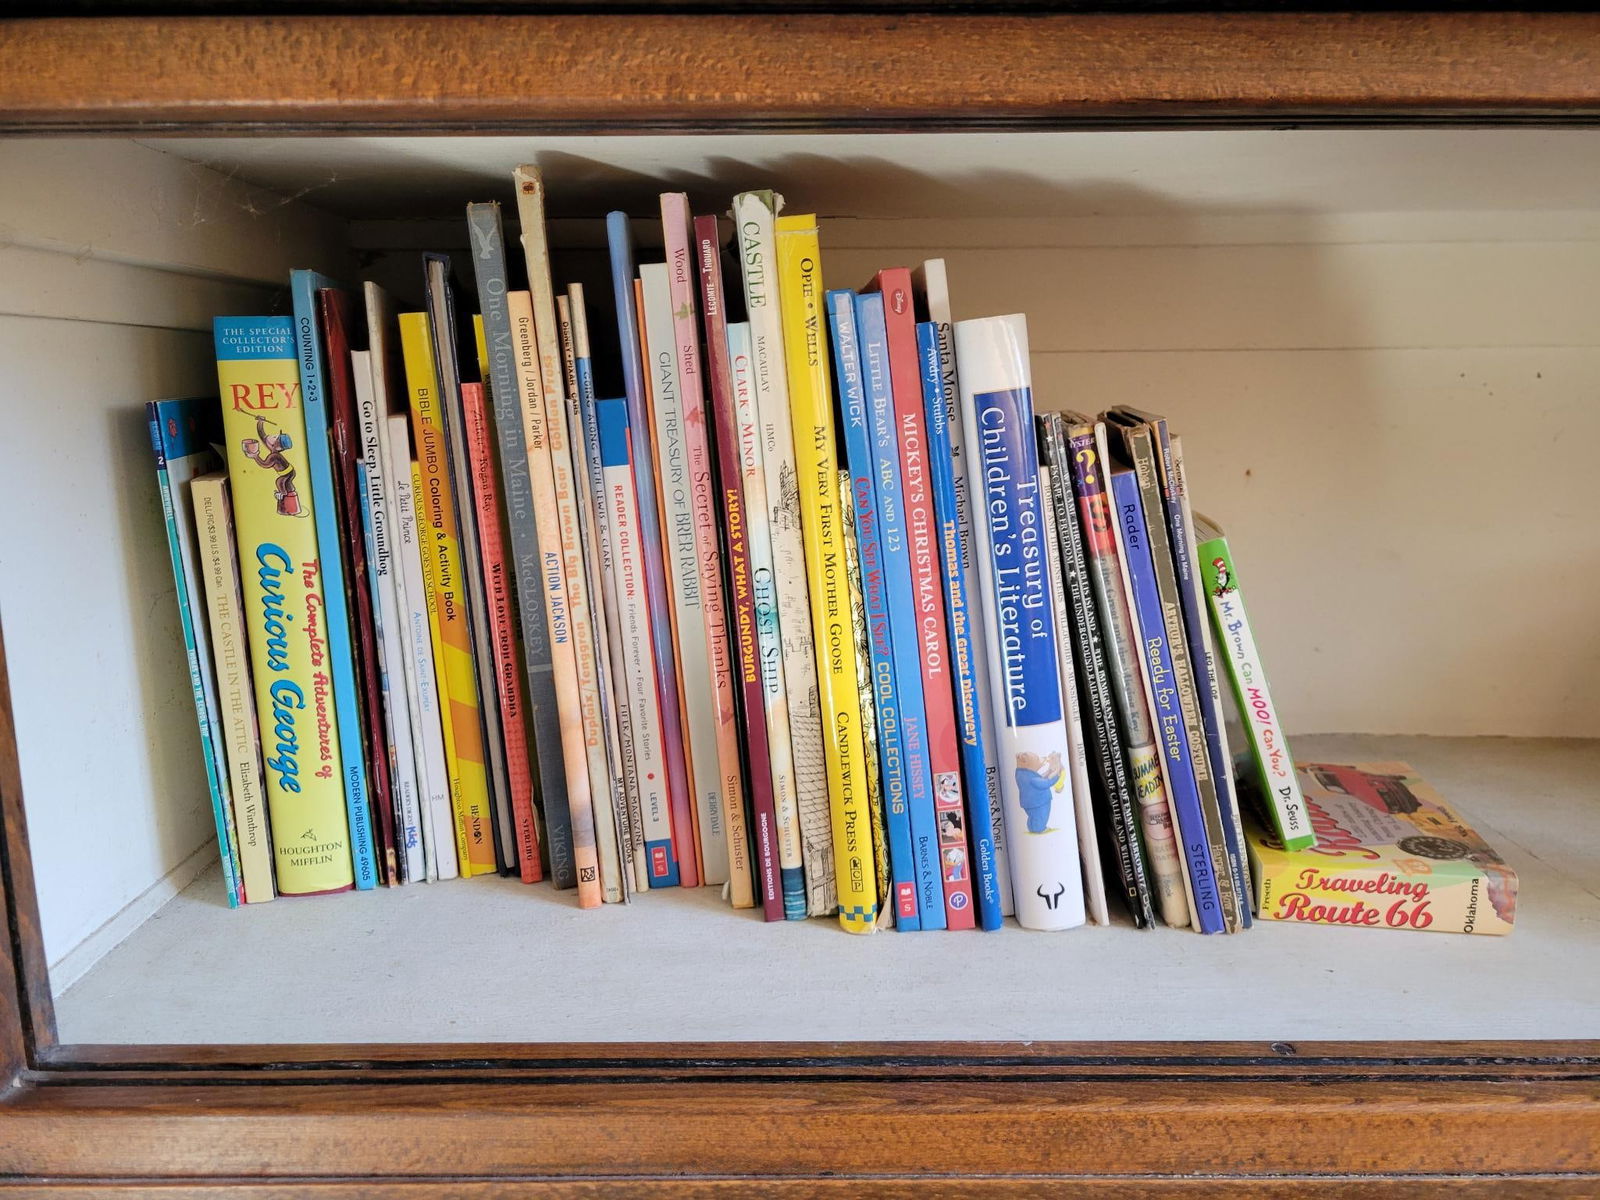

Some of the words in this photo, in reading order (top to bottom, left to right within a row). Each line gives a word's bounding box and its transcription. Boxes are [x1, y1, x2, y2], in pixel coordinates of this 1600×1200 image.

[674, 247, 686, 283] Wood
[743, 221, 767, 308] CASTLE
[800, 257, 813, 296] OPIE
[486, 277, 504, 321] One
[894, 289, 904, 313] Disney
[222, 336, 296, 345] COLLECTOR'S
[224, 328, 246, 336] THE
[249, 327, 293, 336] SPECIAL
[236, 344, 284, 353] EDITION
[300, 316, 314, 370] COUNTING
[804, 315, 817, 366] WELLS
[937, 321, 950, 365] Santa
[494, 331, 524, 420] Morning
[658, 351, 674, 402] GIANT
[682, 344, 694, 375] Shed
[757, 335, 769, 392] MACAULAY
[839, 321, 855, 382] WALTER
[847, 386, 861, 427] WICK
[868, 341, 882, 391] LITTLE
[230, 383, 300, 410] REY
[518, 316, 531, 367] Greenberg
[525, 376, 537, 409] Jordan
[531, 418, 542, 449] Parker
[582, 370, 592, 408] GOING
[734, 354, 747, 408] CLARK
[942, 369, 955, 422] Mouse
[361, 399, 373, 417] Go
[417, 388, 432, 426] BIBLE
[873, 397, 889, 447] BEAR'S
[363, 420, 373, 433] to
[505, 425, 527, 449] in
[587, 412, 597, 450] ALONG
[813, 425, 826, 450] MY
[364, 436, 377, 473] Sleep,
[423, 429, 439, 474] JUMBO
[665, 408, 682, 484] TREASURY
[692, 445, 702, 465] The
[741, 423, 755, 477] MINOR
[903, 413, 923, 503] MICKEY'S
[1162, 447, 1171, 470] Robert
[396, 480, 409, 490] Le
[508, 458, 527, 519] Maine
[556, 465, 568, 500] Bear
[591, 456, 601, 485] WITH
[816, 457, 828, 496] VERY
[880, 458, 893, 490] ABC
[1050, 463, 1063, 499] ESCAPE
[1165, 470, 1176, 504] McCloskey
[370, 475, 383, 507] Little
[399, 492, 411, 512] Petit
[429, 477, 443, 528] Coloring
[595, 489, 604, 519] LEWIS
[614, 484, 626, 527] READER
[672, 488, 685, 508] OF
[694, 471, 713, 531] Secret
[883, 495, 894, 522] AND
[1055, 502, 1065, 515] TO
[401, 515, 413, 544] Prince
[562, 505, 574, 550] Brown
[599, 523, 607, 534] &
[675, 512, 692, 552] BRER
[727, 489, 741, 539] STORY!
[819, 503, 832, 546] FIRST
[1123, 503, 1139, 549] Rader
[1173, 513, 1181, 527] One
[374, 510, 389, 576] Groundhog
[436, 533, 444, 541] &
[601, 537, 610, 570] CLARK
[702, 535, 712, 547] of
[732, 541, 743, 553] A
[887, 527, 900, 552] 123
[943, 519, 958, 578] Thomas
[1017, 475, 1044, 609] Treasury
[1059, 518, 1073, 564] FREEDOM
[1176, 527, 1184, 553] Morning
[301, 559, 319, 589] The
[437, 545, 451, 588] Activity
[544, 552, 561, 591] ACTION
[565, 555, 580, 578] Big
[619, 530, 634, 599] COLLECTION:
[912, 507, 934, 612] CHRISTMAS
[981, 407, 1011, 555] Children's
[998, 567, 1027, 710] Literature
[1180, 553, 1186, 561] in
[569, 583, 581, 608] The
[680, 556, 699, 608] RABBIT
[701, 551, 722, 613] Saying
[733, 555, 747, 599] WHAT
[823, 552, 837, 618] MOTHER
[949, 580, 963, 607] and
[216, 594, 229, 618] THE
[256, 542, 294, 672] Curious
[445, 592, 456, 622] Book
[519, 553, 544, 655] McCLOSKEY
[550, 595, 568, 644] JACKSON
[754, 567, 776, 638] GHOST
[1220, 602, 1234, 621] Mr.
[303, 590, 326, 667] Complete
[952, 610, 968, 634] the
[1030, 618, 1047, 638] of
[1228, 619, 1246, 660] Brown
[220, 621, 236, 668] CASTLE
[710, 619, 727, 688] Thanks
[739, 602, 755, 682] BURGUNDY,
[829, 622, 842, 674] GOOSE
[923, 616, 940, 679] CAROL
[955, 637, 972, 675] Great
[1149, 636, 1169, 683] Ready
[1204, 650, 1213, 666] LEO
[227, 671, 238, 686] IN
[761, 645, 778, 693] SHIP
[877, 661, 892, 704] COOL
[1207, 667, 1216, 682] THE
[1241, 661, 1254, 685] Can
[229, 688, 242, 713] THE
[960, 678, 976, 745] Discovery
[1158, 687, 1174, 710] for
[1209, 685, 1219, 700] LOP
[1247, 687, 1271, 725] MOO!
[234, 715, 247, 754] ATTIC
[313, 670, 332, 762] Adventures
[269, 679, 305, 794] George
[1162, 714, 1180, 761] Easter
[315, 764, 333, 779] of
[882, 706, 903, 814] COLLECTIONS
[1269, 750, 1286, 778] You?
[239, 761, 253, 802] Elizabeth
[349, 765, 360, 804] MODERN
[726, 774, 737, 809] Simon
[836, 711, 852, 805] CANDLEWICK
[844, 810, 856, 852] PRESS
[1278, 786, 1292, 804] Dr.
[245, 803, 257, 847] Winthrop
[354, 805, 367, 854] PUBLISHING
[468, 804, 482, 844] BENDON
[730, 812, 740, 821] &
[1283, 803, 1299, 831] Seuss
[279, 841, 343, 856] HOUGHTON
[405, 825, 417, 849] Kids
[552, 824, 569, 880] VIKING
[732, 824, 743, 870] Schuster
[918, 836, 928, 869] BARNES
[290, 854, 333, 868] MIFFLIN
[360, 856, 370, 881] 49605
[921, 870, 931, 880] &
[1190, 843, 1214, 910] STERLING
[923, 881, 933, 909] NOBLE
[1296, 868, 1430, 902] Traveling
[1273, 893, 1381, 926] Route
[1386, 899, 1433, 929] 66
[1463, 878, 1480, 934] Oklahoma
